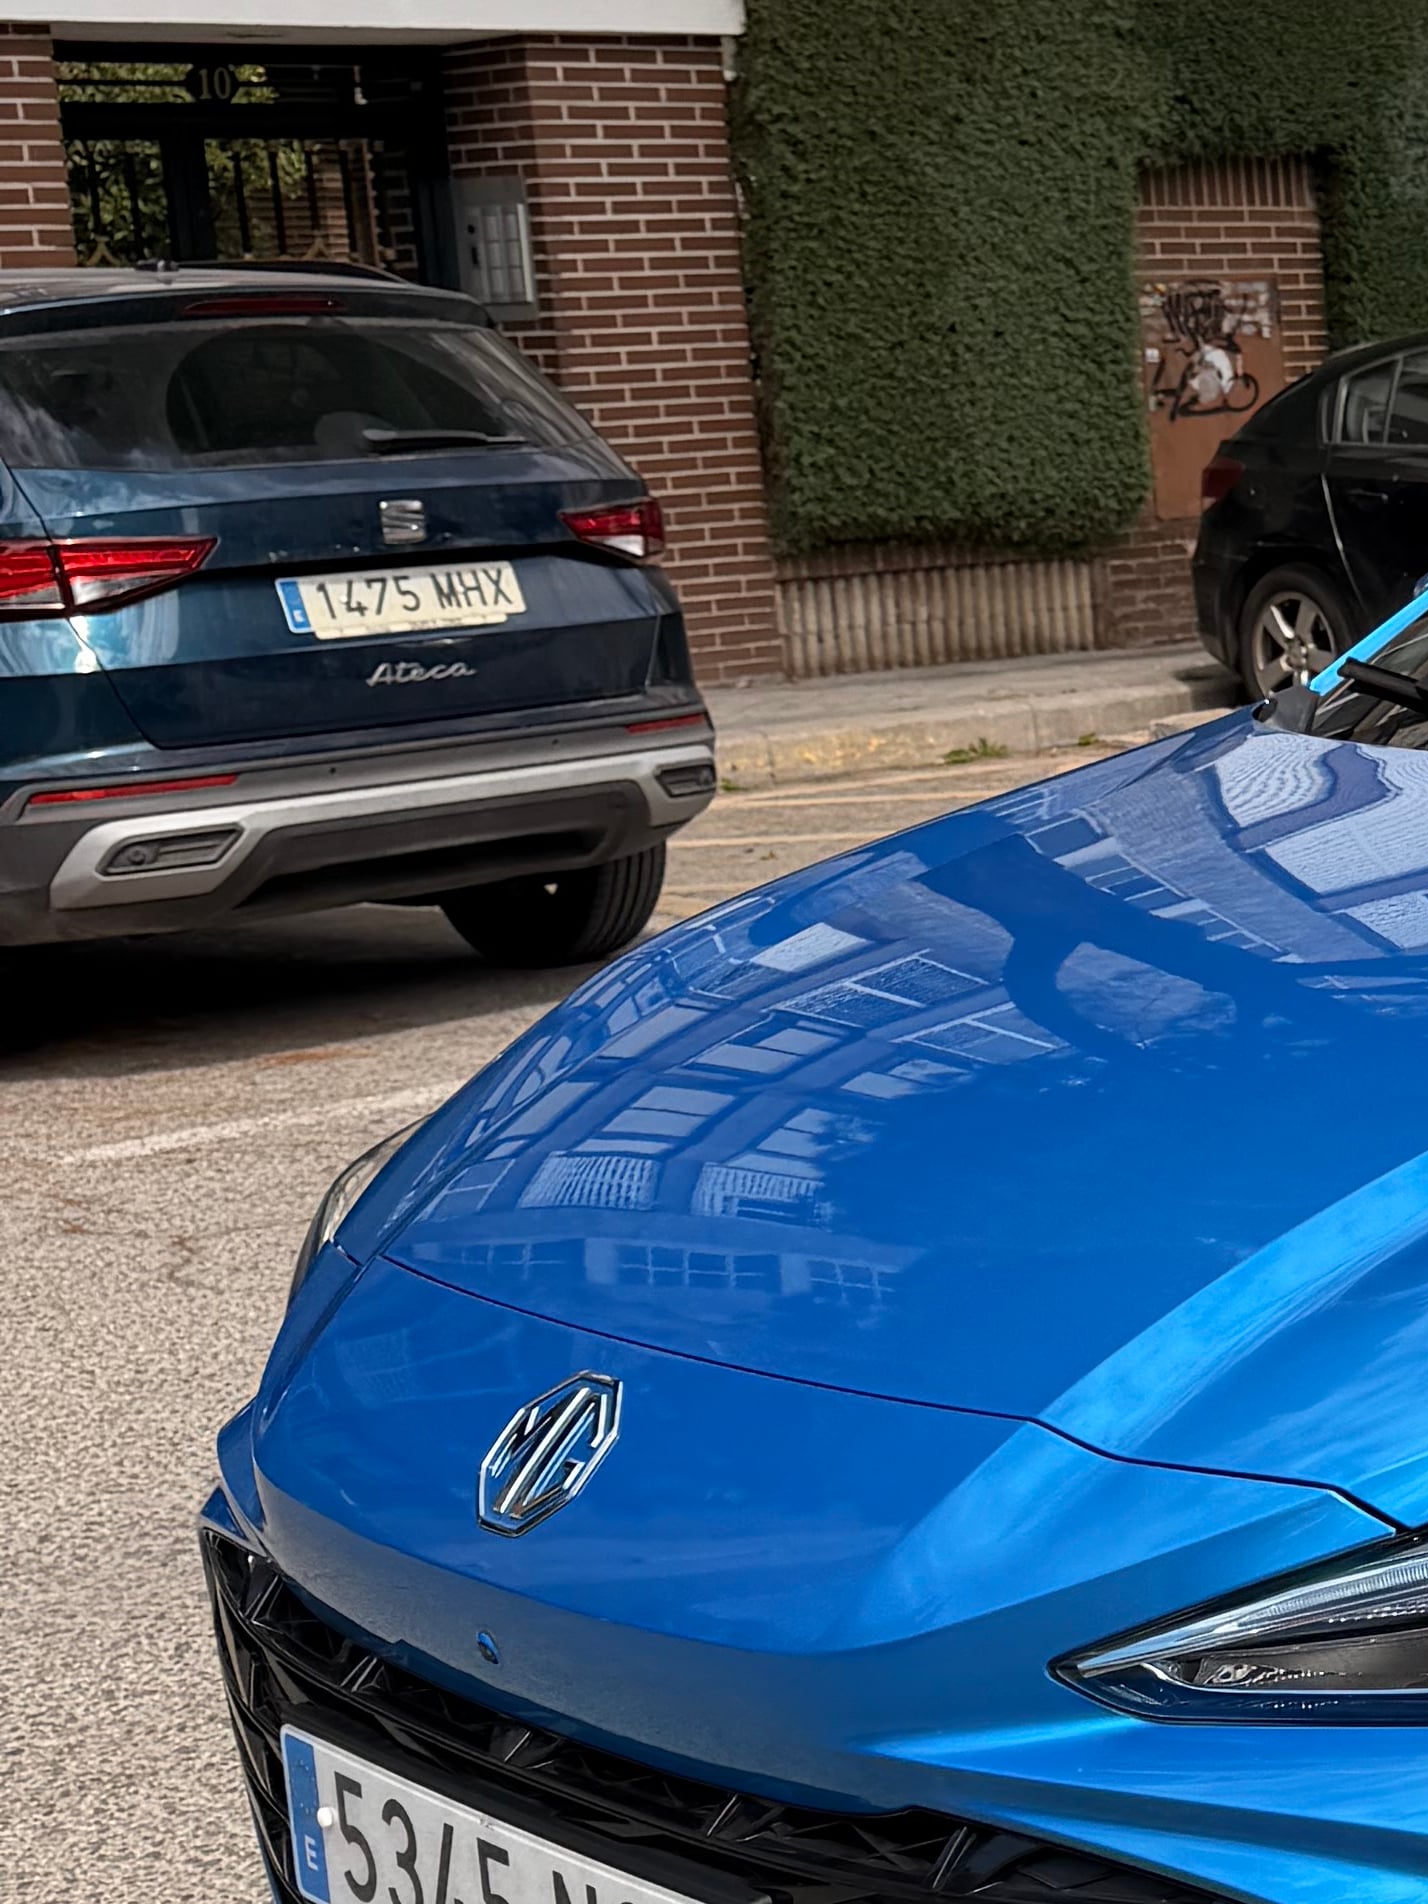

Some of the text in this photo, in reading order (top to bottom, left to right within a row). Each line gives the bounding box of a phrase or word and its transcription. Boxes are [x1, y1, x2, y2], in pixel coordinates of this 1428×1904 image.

[198, 66, 232, 100] 10
[316, 567, 513, 620] 1475 MHX
[366, 661, 477, 688] Ateca
[486, 1385, 610, 1520] MG
[303, 1835, 319, 1872] E
